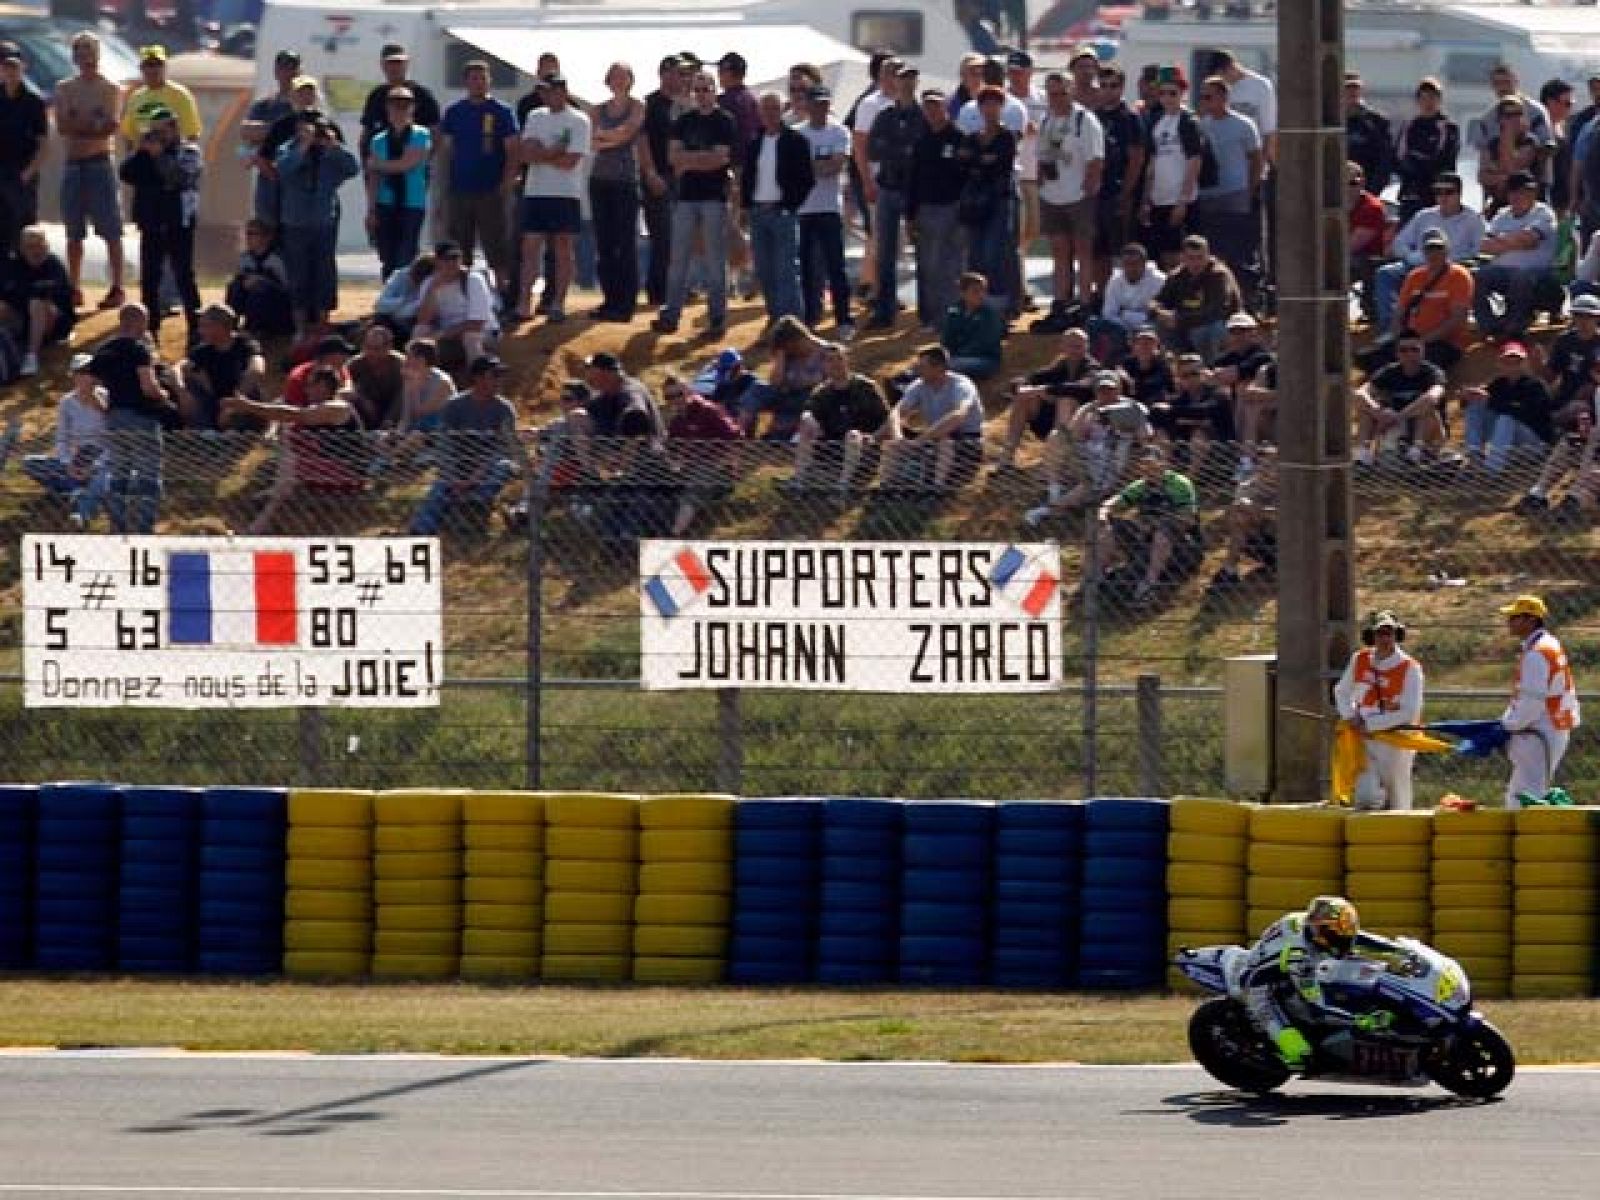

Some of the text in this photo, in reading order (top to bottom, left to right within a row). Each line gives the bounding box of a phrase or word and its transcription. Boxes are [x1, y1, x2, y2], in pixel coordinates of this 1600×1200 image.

[34, 543, 76, 584] 14
[130, 547, 161, 587] 16
[309, 545, 356, 583] 53
[386, 544, 431, 584] 69
[707, 549, 991, 608] SUPPORTERS
[46, 608, 160, 650] 5 63
[311, 607, 357, 648] 80
[678, 622, 1051, 683] JOHANN ZARCO
[42, 659, 161, 699] Donnez
[184, 675, 246, 698] nous
[295, 660, 316, 697] la
